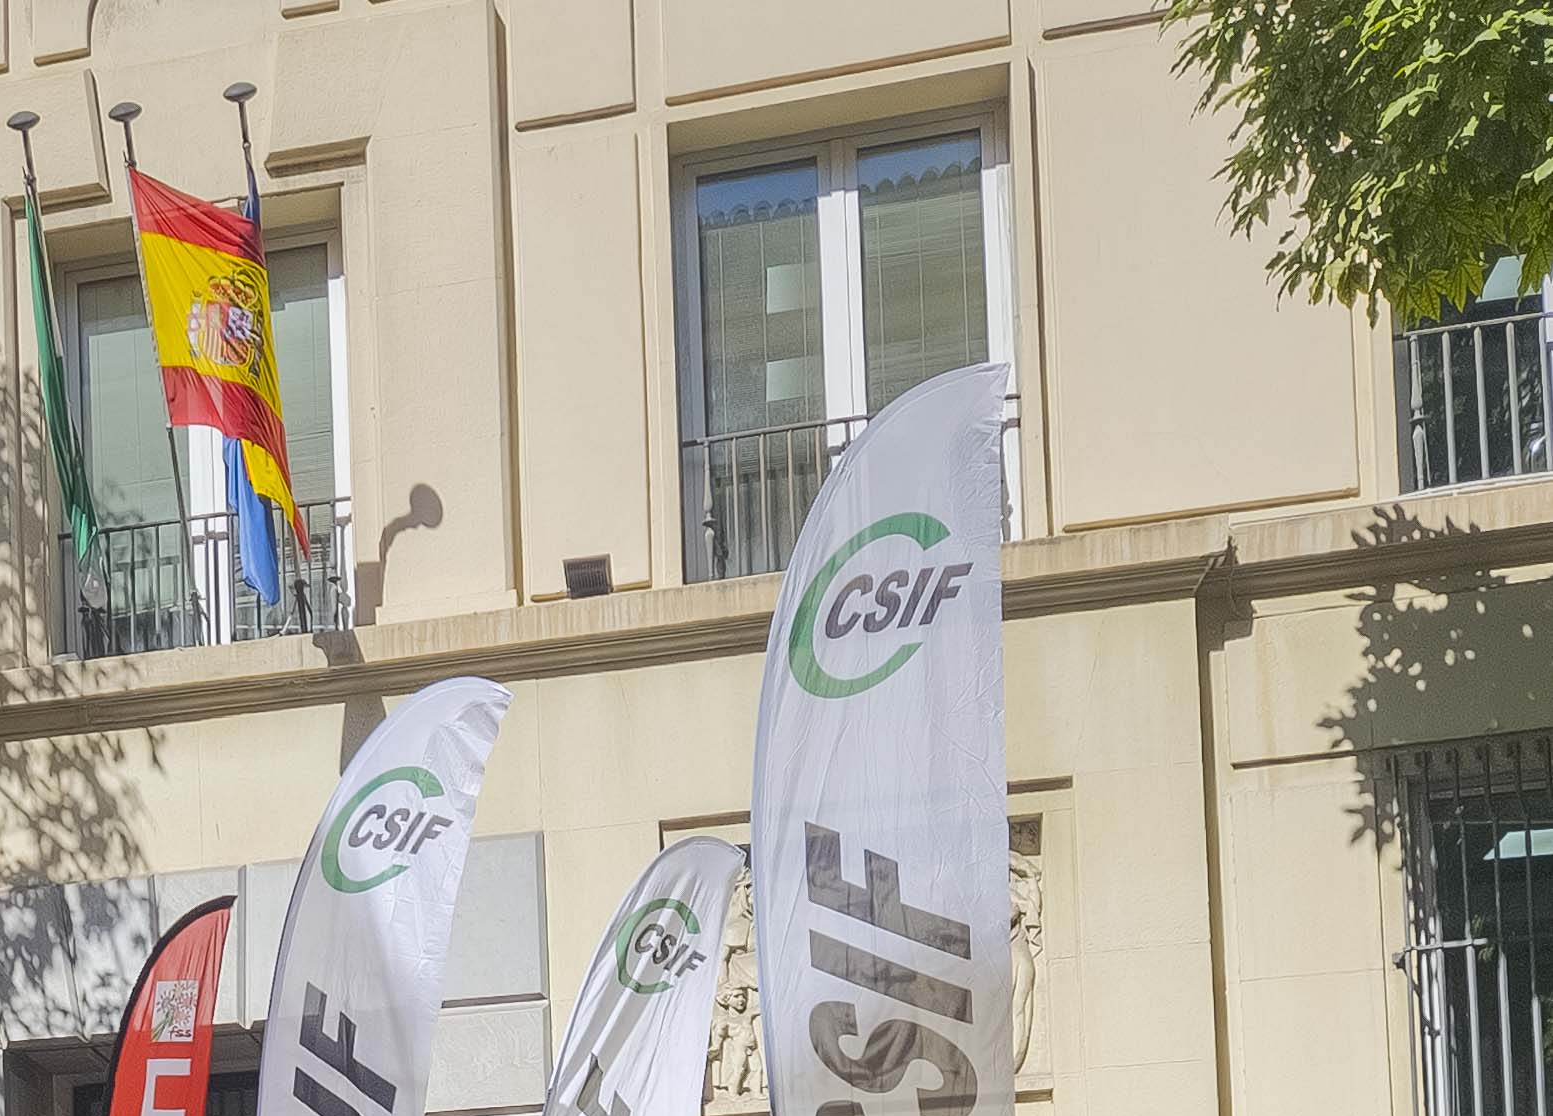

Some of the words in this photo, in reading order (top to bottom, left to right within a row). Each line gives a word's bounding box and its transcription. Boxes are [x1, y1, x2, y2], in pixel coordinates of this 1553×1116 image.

[825, 562, 973, 640] CSIF
[348, 803, 454, 855] CSIF
[634, 922, 706, 980] CSIF
